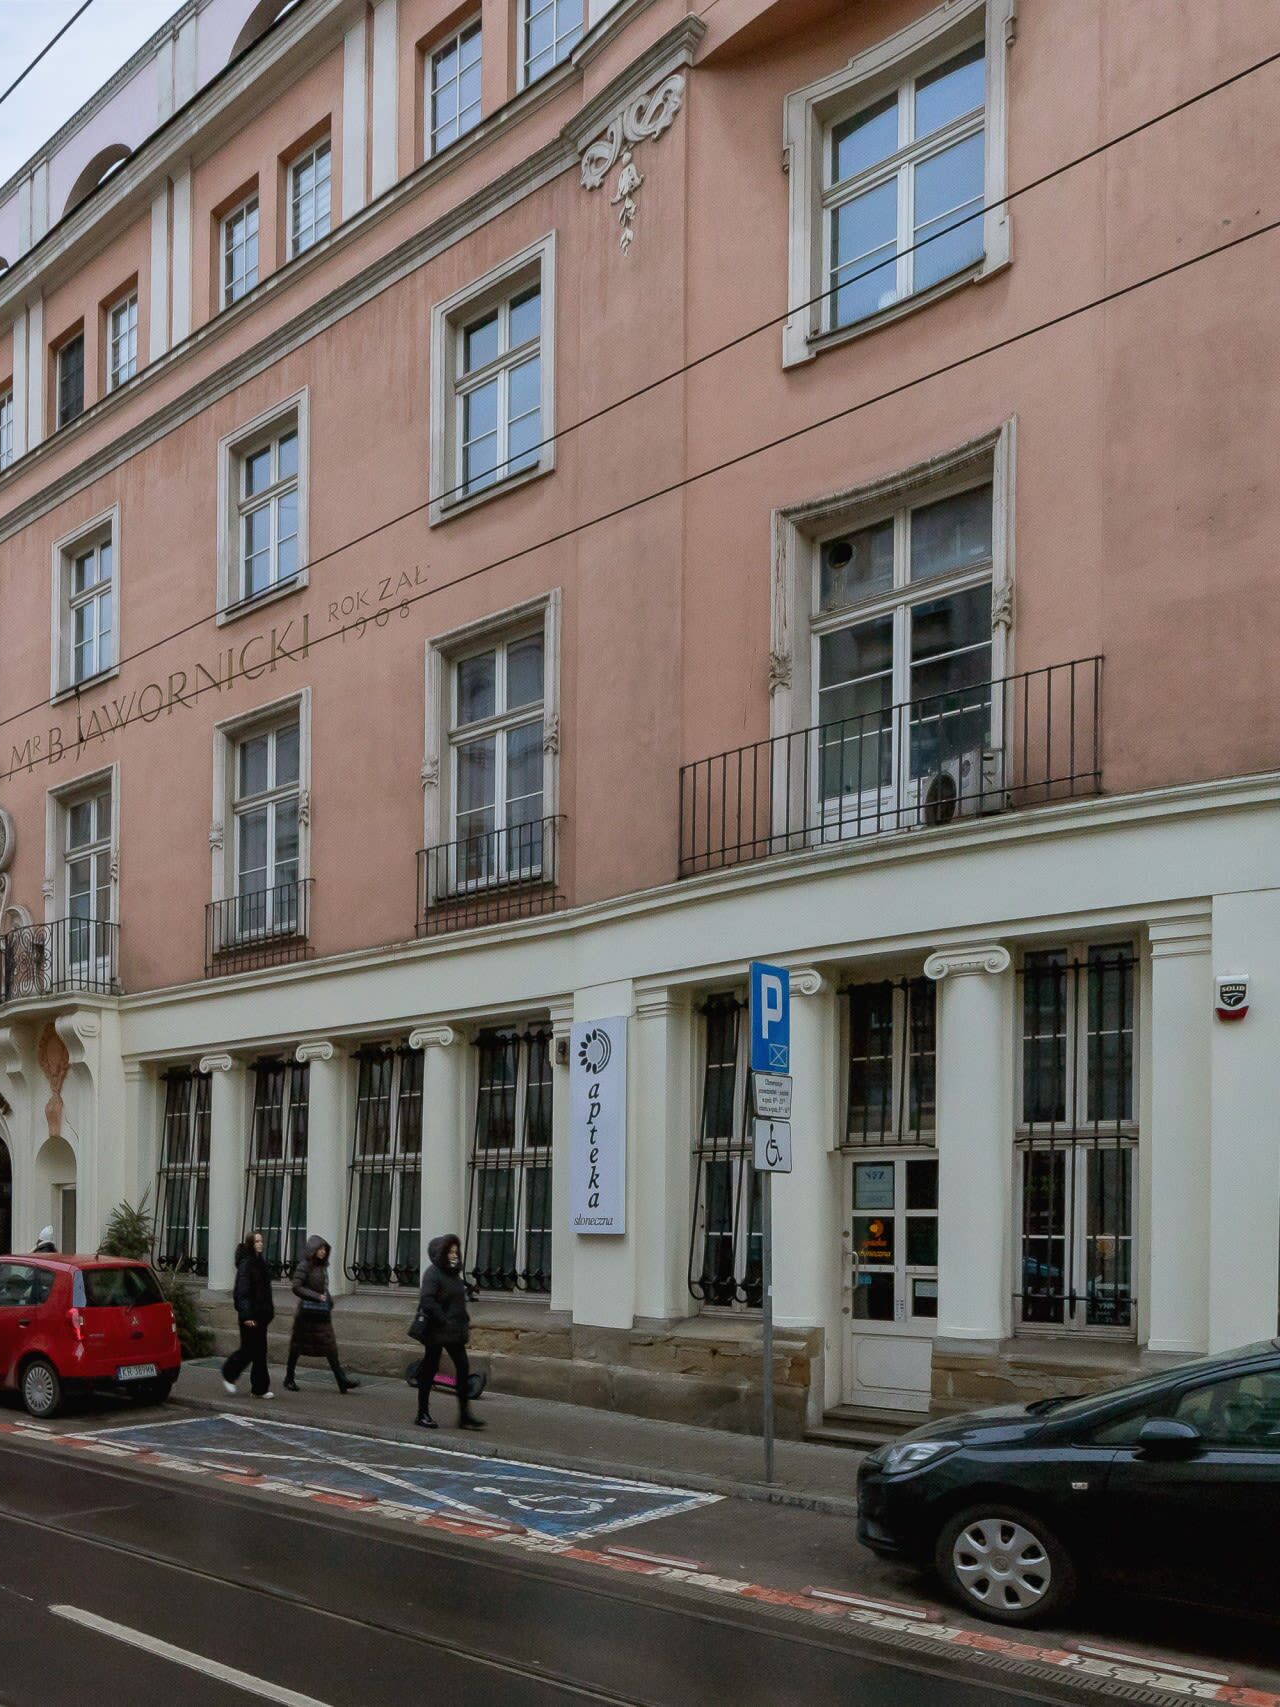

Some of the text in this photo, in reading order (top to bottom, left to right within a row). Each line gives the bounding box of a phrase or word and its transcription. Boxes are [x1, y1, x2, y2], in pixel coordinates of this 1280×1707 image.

[328, 588, 370, 623] ROK
[341, 598, 410, 645] 1908
[75, 613, 309, 763] JAWORNICKI
[761, 973, 783, 1040] P
[1221, 985, 1246, 993] SOLID
[586, 1082, 601, 1209] apteka
[574, 1213, 614, 1226] słoneczna
